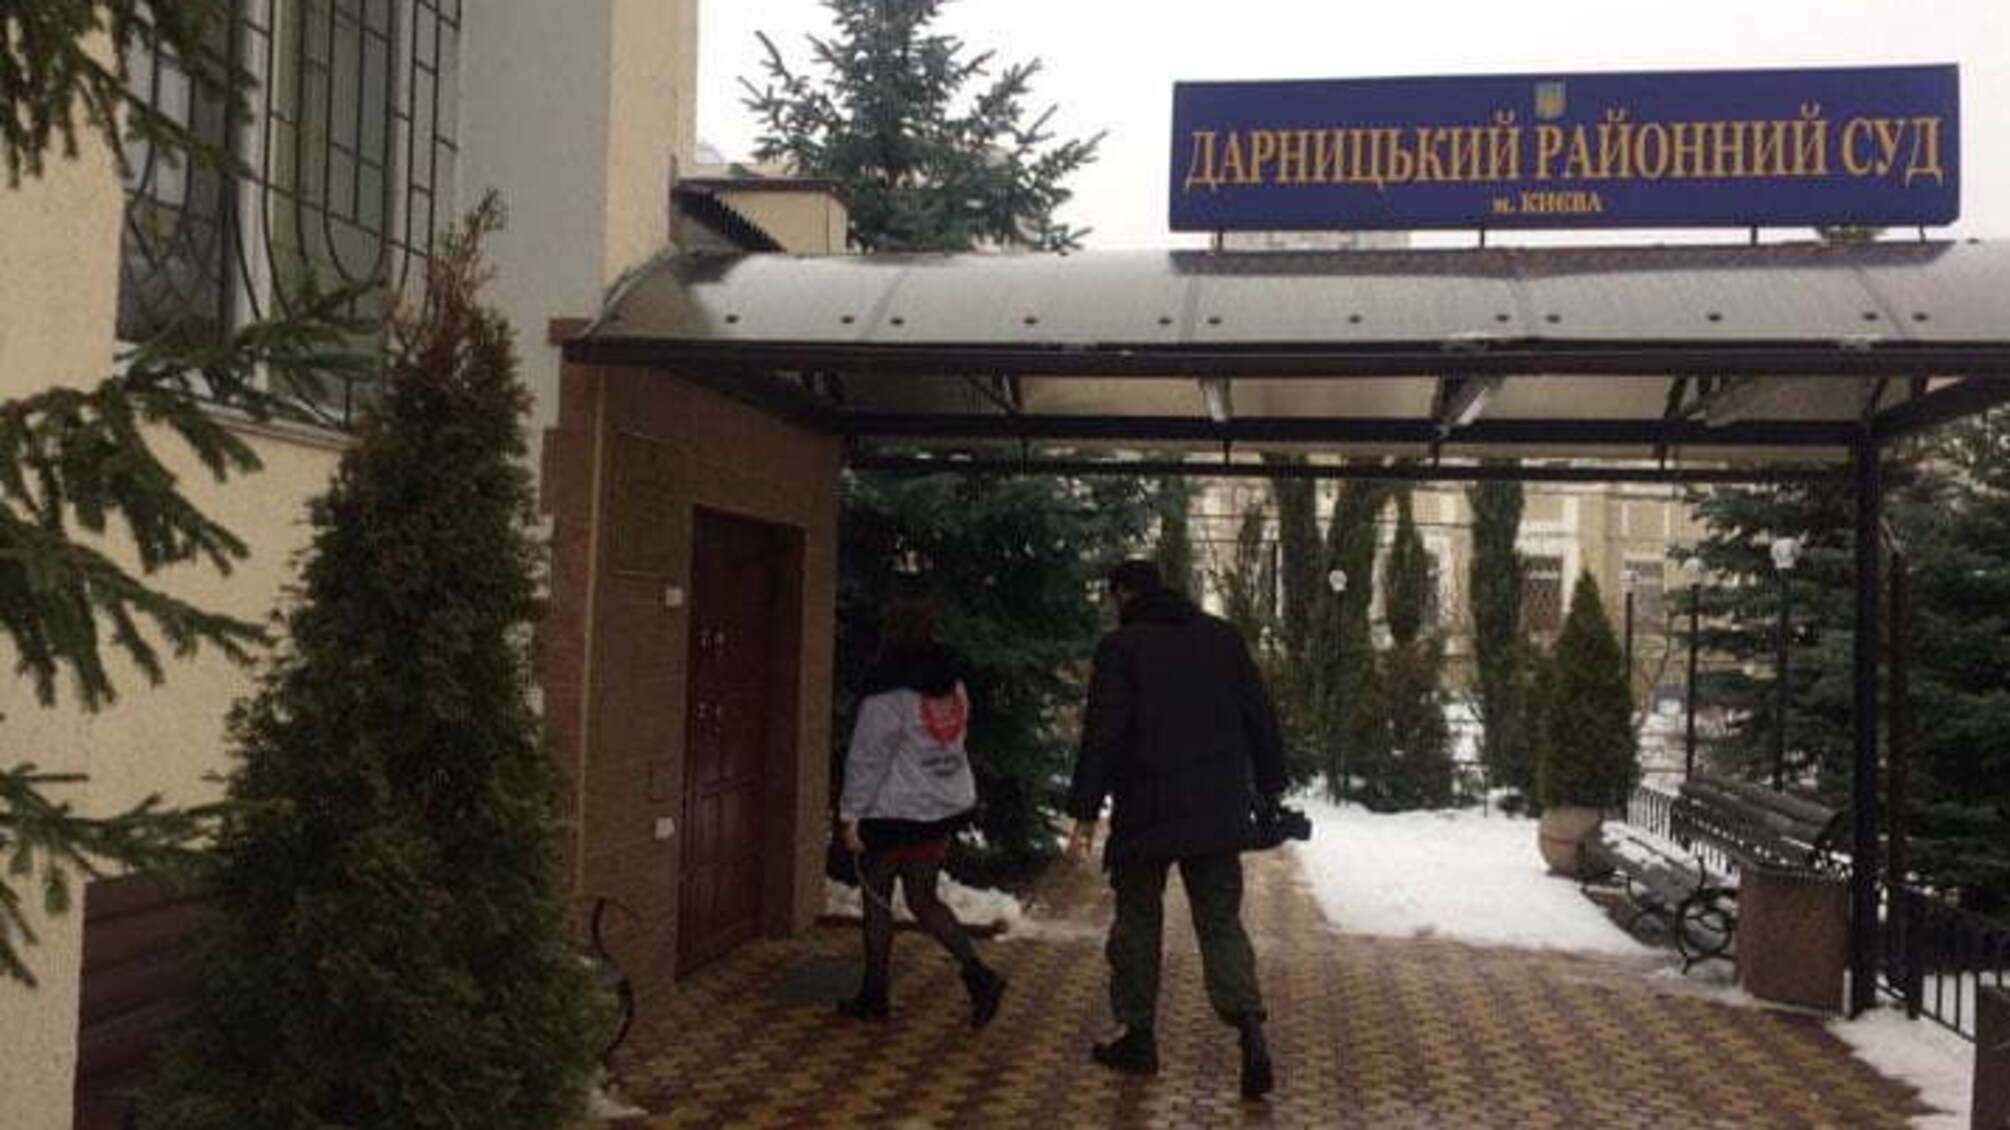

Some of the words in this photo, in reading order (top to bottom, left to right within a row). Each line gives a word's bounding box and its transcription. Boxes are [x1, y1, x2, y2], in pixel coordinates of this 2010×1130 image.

[1186, 109, 1521, 191] ДАРНИЦЬКИЙ
[1535, 104, 1828, 180] РАЙОННИЙ
[1842, 117, 1944, 187] СУД
